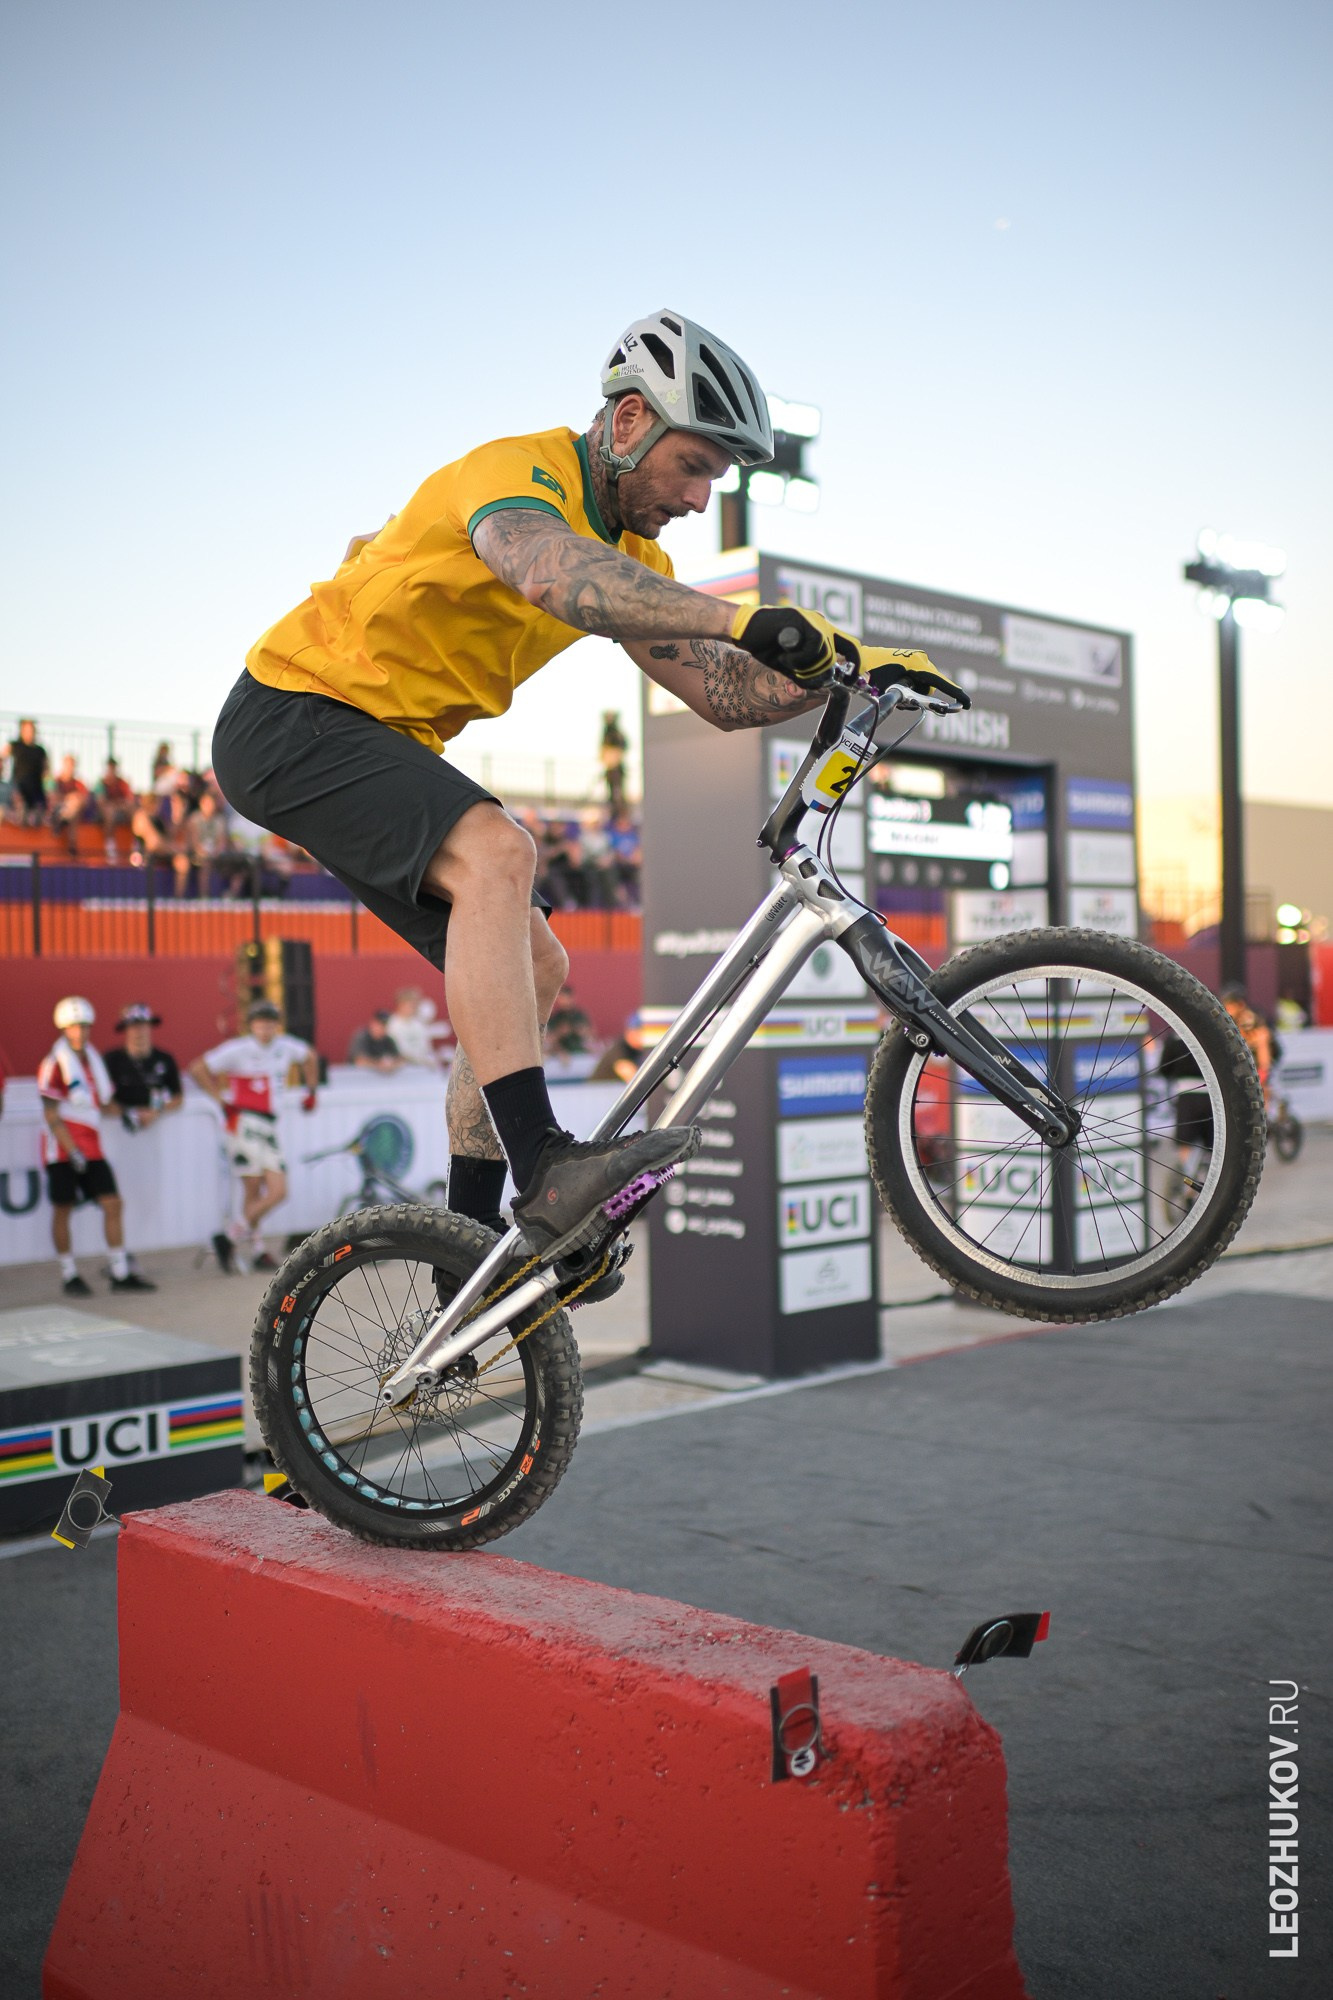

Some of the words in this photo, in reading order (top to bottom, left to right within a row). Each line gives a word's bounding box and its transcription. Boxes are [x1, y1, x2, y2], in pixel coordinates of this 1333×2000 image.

[924, 711, 1010, 748] FINISH
[830, 766, 857, 793] 2
[929, 1008, 960, 1036] ULTIMATE
[801, 1195, 858, 1231] UCI
[60, 1412, 159, 1466] UCI
